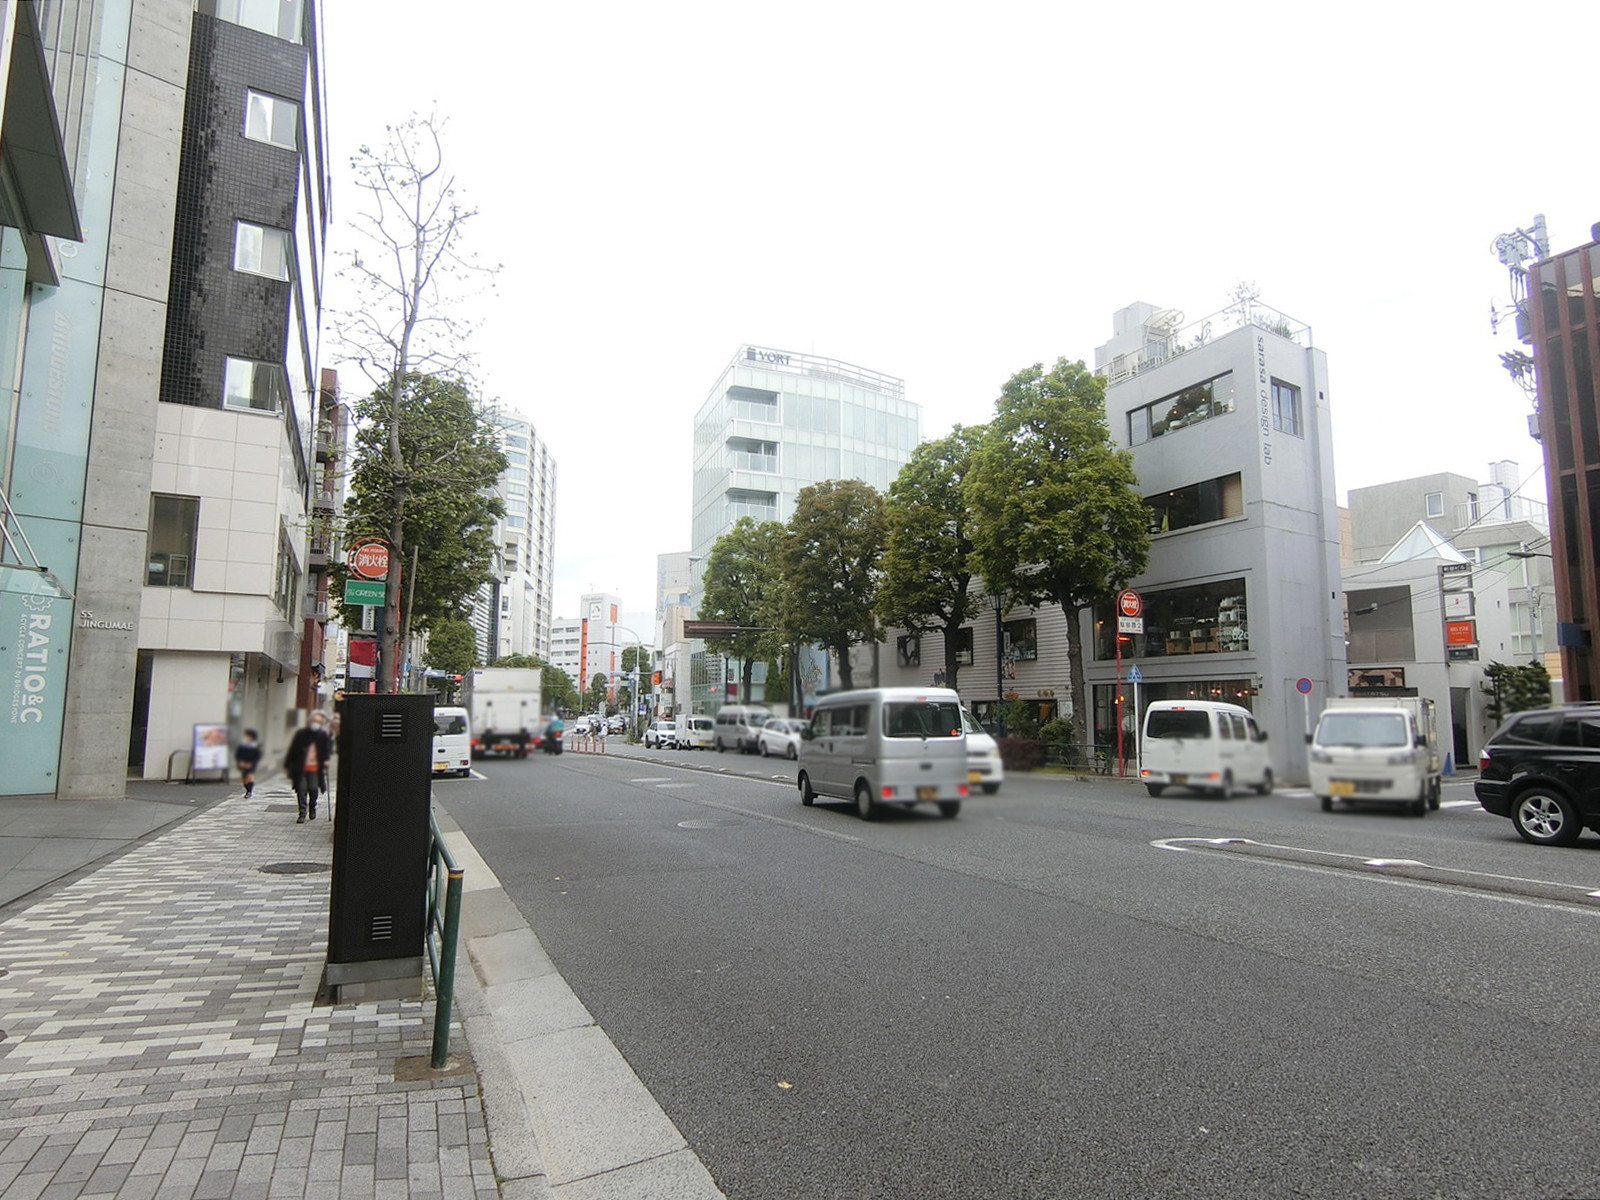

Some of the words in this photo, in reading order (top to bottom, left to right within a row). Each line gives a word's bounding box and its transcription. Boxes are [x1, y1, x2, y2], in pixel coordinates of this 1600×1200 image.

[759, 350, 791, 365] VORT
[1257, 335, 1267, 384] sarasa
[1260, 389, 1271, 437] design
[1263, 442, 1272, 466] lab
[358, 553, 388, 568] 消火栓
[80, 610, 93, 619] SS
[79, 620, 134, 631] JINGUMAE
[20, 614, 52, 723] RATIO&C
